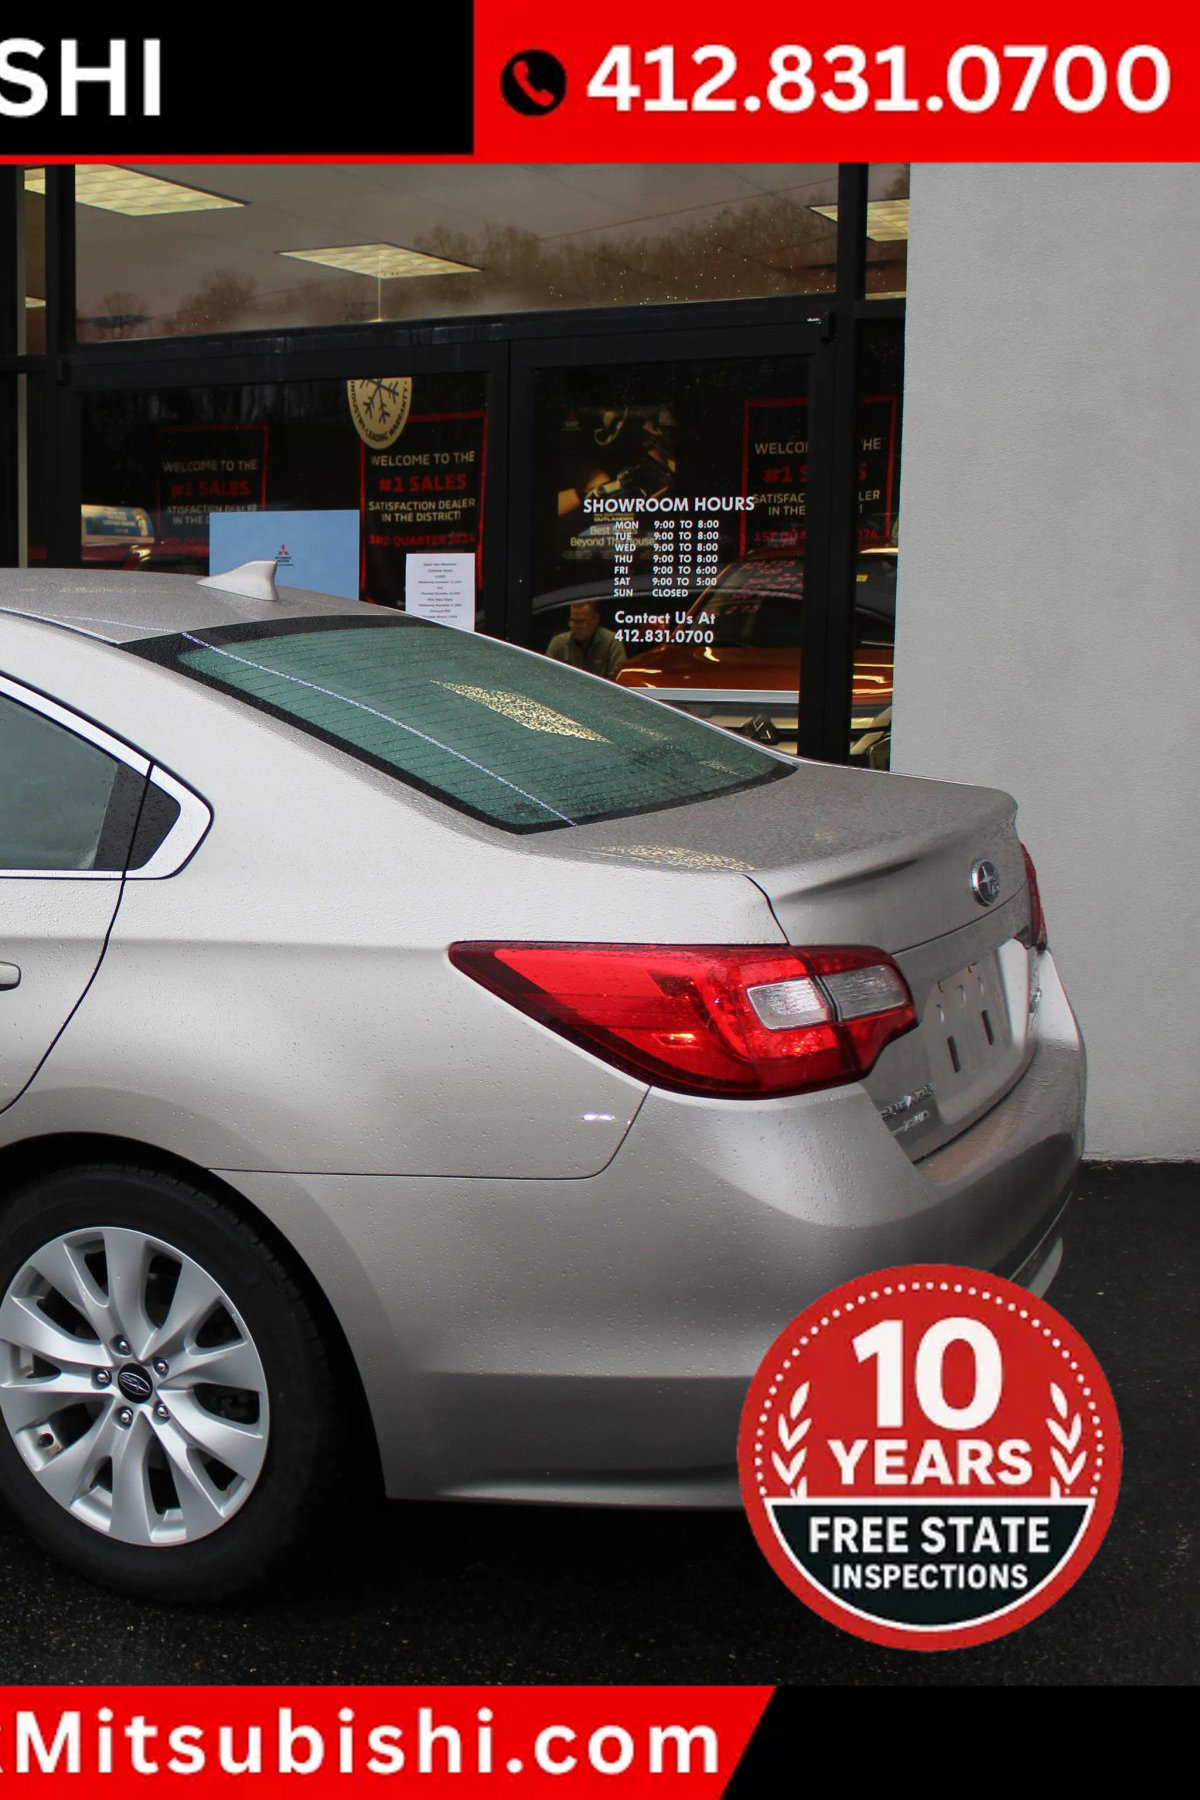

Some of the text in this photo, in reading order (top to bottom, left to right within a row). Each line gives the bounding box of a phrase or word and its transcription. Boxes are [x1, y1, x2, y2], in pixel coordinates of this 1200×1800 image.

[370, 450, 475, 467] WELCOME TO THE
[162, 459, 257, 473] WELCOME TO THE
[197, 479, 251, 497] SALES
[378, 472, 467, 493] #1 SALES
[368, 498, 476, 511] SATISFACTION DEALER
[583, 496, 755, 513] SHOWROOM HOURS
[768, 505, 806, 517] IN THE
[185, 515, 206, 525] THE
[382, 512, 392, 523] IN
[395, 512, 414, 523] THE
[614, 520, 720, 530] MON 9:00 TO 8:00
[394, 534, 446, 546] QUARTER
[570, 536, 605, 548] Beyond
[614, 532, 719, 541] TUE 9:00 TO 8:00
[614, 543, 719, 552] WED 9:00 TO 8:00
[614, 555, 633, 563] THU
[653, 554, 674, 563] 9:00
[679, 554, 692, 563] TO
[697, 554, 718, 563] 8:00
[614, 566, 718, 575] FRI 9:00 TO 6:00
[614, 577, 717, 586] SAT 9:00 TO 5:00
[613, 588, 689, 598] SUN CLOSED
[614, 610, 716, 625] Contact Us At
[614, 629, 714, 644] 412.831.0700
